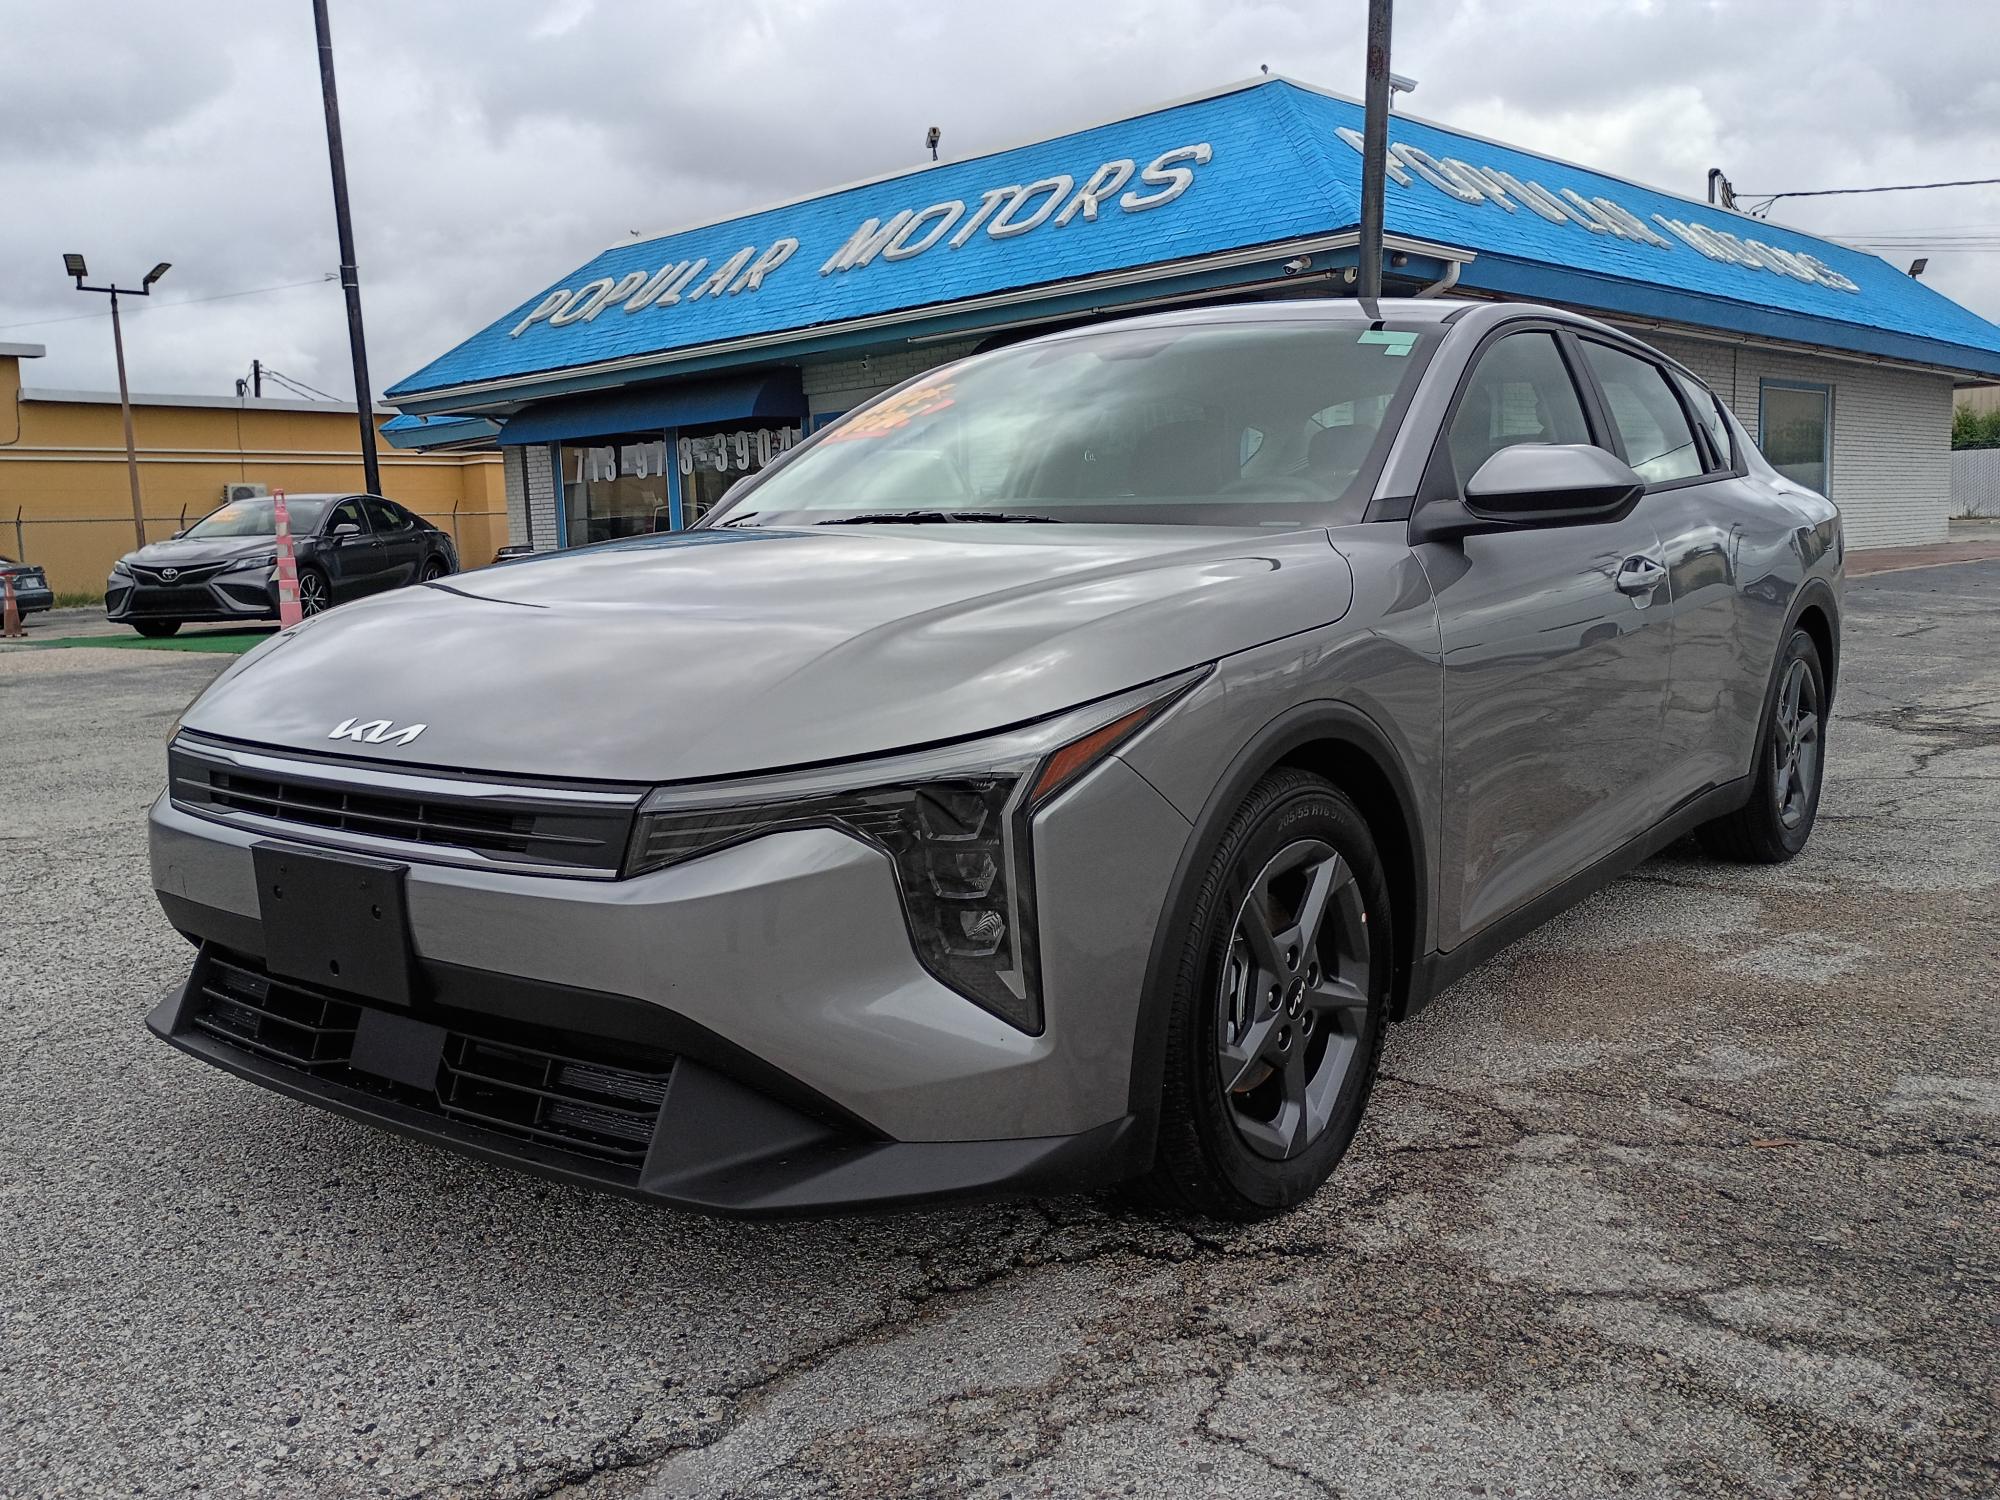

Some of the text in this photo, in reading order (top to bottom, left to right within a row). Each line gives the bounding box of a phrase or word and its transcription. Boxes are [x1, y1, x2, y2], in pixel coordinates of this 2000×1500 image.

[509, 142, 1213, 338] POPULAR MOTORS
[327, 717, 428, 747] KIA
